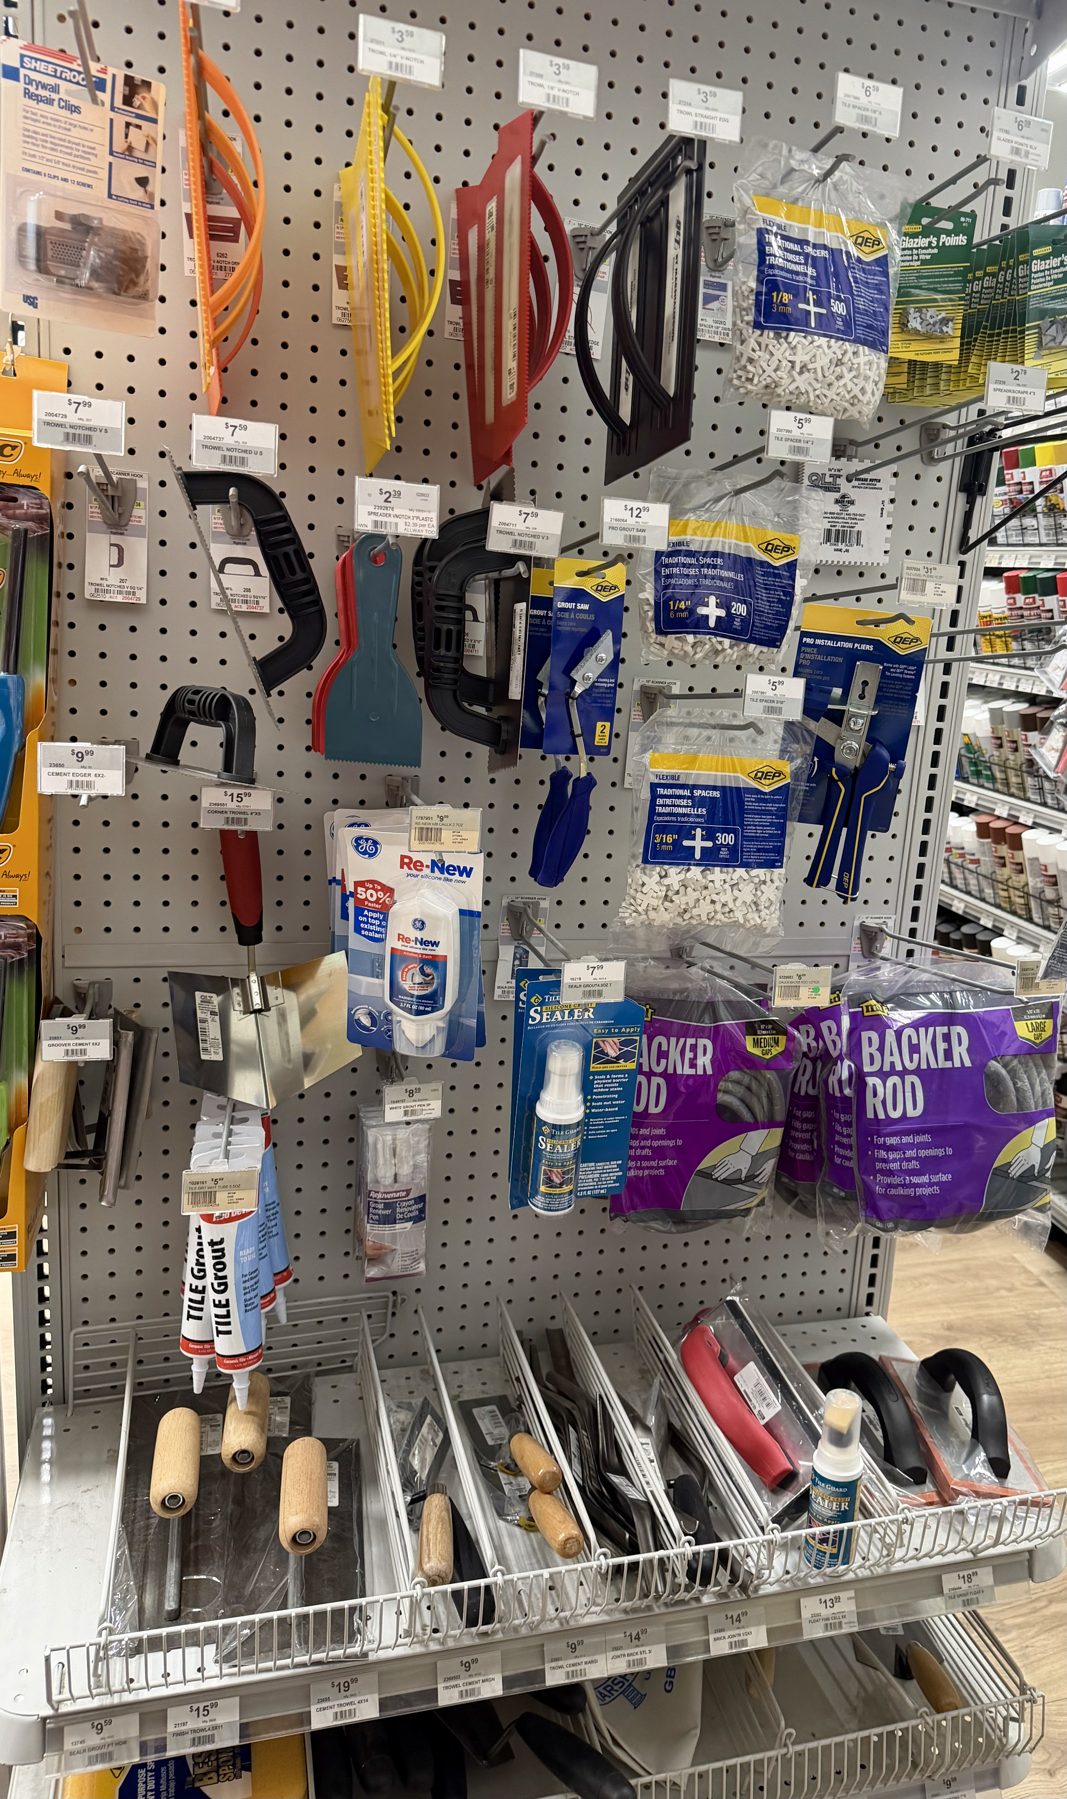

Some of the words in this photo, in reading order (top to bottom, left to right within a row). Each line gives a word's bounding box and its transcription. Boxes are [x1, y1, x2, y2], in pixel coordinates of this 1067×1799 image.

[23, 57, 93, 86] SHEETROC
[23, 74, 60, 94] Drywall
[23, 87, 55, 106] Repair
[57, 97, 82, 115] Clips
[854, 235, 881, 248] QEP
[900, 236, 937, 248] Glazier's
[939, 233, 968, 246] Points
[772, 292, 793, 304] 1/8"
[830, 299, 847, 316] 500
[42, 421, 68, 430] TROWEL
[69, 424, 98, 433] NOTCHED
[201, 444, 225, 452] TROWEL
[226, 447, 253, 455] NOTCHED
[808, 472, 843, 486] QLT
[496, 529, 517, 537] TROWEL
[517, 532, 541, 540] NOTCHED
[764, 542, 792, 555] QEP
[662, 556, 697, 565] TRADITIONAL
[699, 557, 724, 565] SPACERS
[700, 569, 744, 581] TRADITIONNELLES
[594, 583, 617, 593] QEP
[557, 601, 576, 610] GROUT
[577, 602, 590, 611] SAW
[668, 600, 691, 610] 1/4"
[731, 601, 747, 616] 200
[815, 639, 853, 649] INSTALLATION
[854, 643, 874, 651] PLIERS
[893, 636, 918, 645] QEP
[600, 723, 606, 734] 2
[753, 770, 781, 780] QEP
[656, 788, 691, 796] TRADITIONAL
[693, 790, 720, 798] SPACERS
[656, 798, 692, 806] ENTRETOISES
[655, 806, 706, 815] TRADITIONNELLES
[654, 834, 678, 844] 3/16"
[715, 833, 735, 845] 300
[400, 854, 474, 878] Re-New
[357, 886, 393, 905] 50%
[363, 909, 384, 919] Apply
[368, 917, 381, 926] top
[361, 930, 386, 939] sealant
[397, 933, 440, 948] Re-New
[528, 1006, 595, 1024] SEALER
[1025, 1021, 1047, 1033] LARGE
[752, 1037, 780, 1049] MEDIUM
[1033, 1033, 1043, 1041] GAPS
[761, 1048, 773, 1056] GAPS
[861, 1026, 972, 1072] BACKER
[865, 1074, 924, 1120] ROD
[651, 1139, 675, 1147] openings
[873, 1136, 884, 1145] For
[885, 1136, 901, 1146] gaps
[901, 1135, 914, 1143] and
[915, 1134, 932, 1143] joints
[874, 1150, 888, 1158] Fills
[888, 1150, 904, 1160] gaps
[904, 1149, 917, 1158] and
[917, 1148, 945, 1159] openings
[946, 1147, 953, 1155] to
[876, 1161, 900, 1171] prevent
[901, 1160, 920, 1169] drafts
[876, 1174, 904, 1184] Provides
[910, 1173, 929, 1182] sound
[930, 1172, 952, 1182] surface
[369, 1191, 407, 1200] Rejuvenate
[876, 1185, 885, 1194] for
[886, 1185, 914, 1196] caulking
[915, 1184, 940, 1195] projects
[396, 1199, 415, 1208] Crayon
[404, 1210, 419, 1219] Coulis
[208, 1237, 229, 1294] Grout
[187, 1280, 207, 1321] TILE
[214, 1297, 232, 1338] TILE
[442, 1683, 461, 1691] TROWEL
[462, 1680, 481, 1688] CEMENT
[315, 1705, 336, 1713] CEMENT
[337, 1701, 356, 1709] TROWEL
